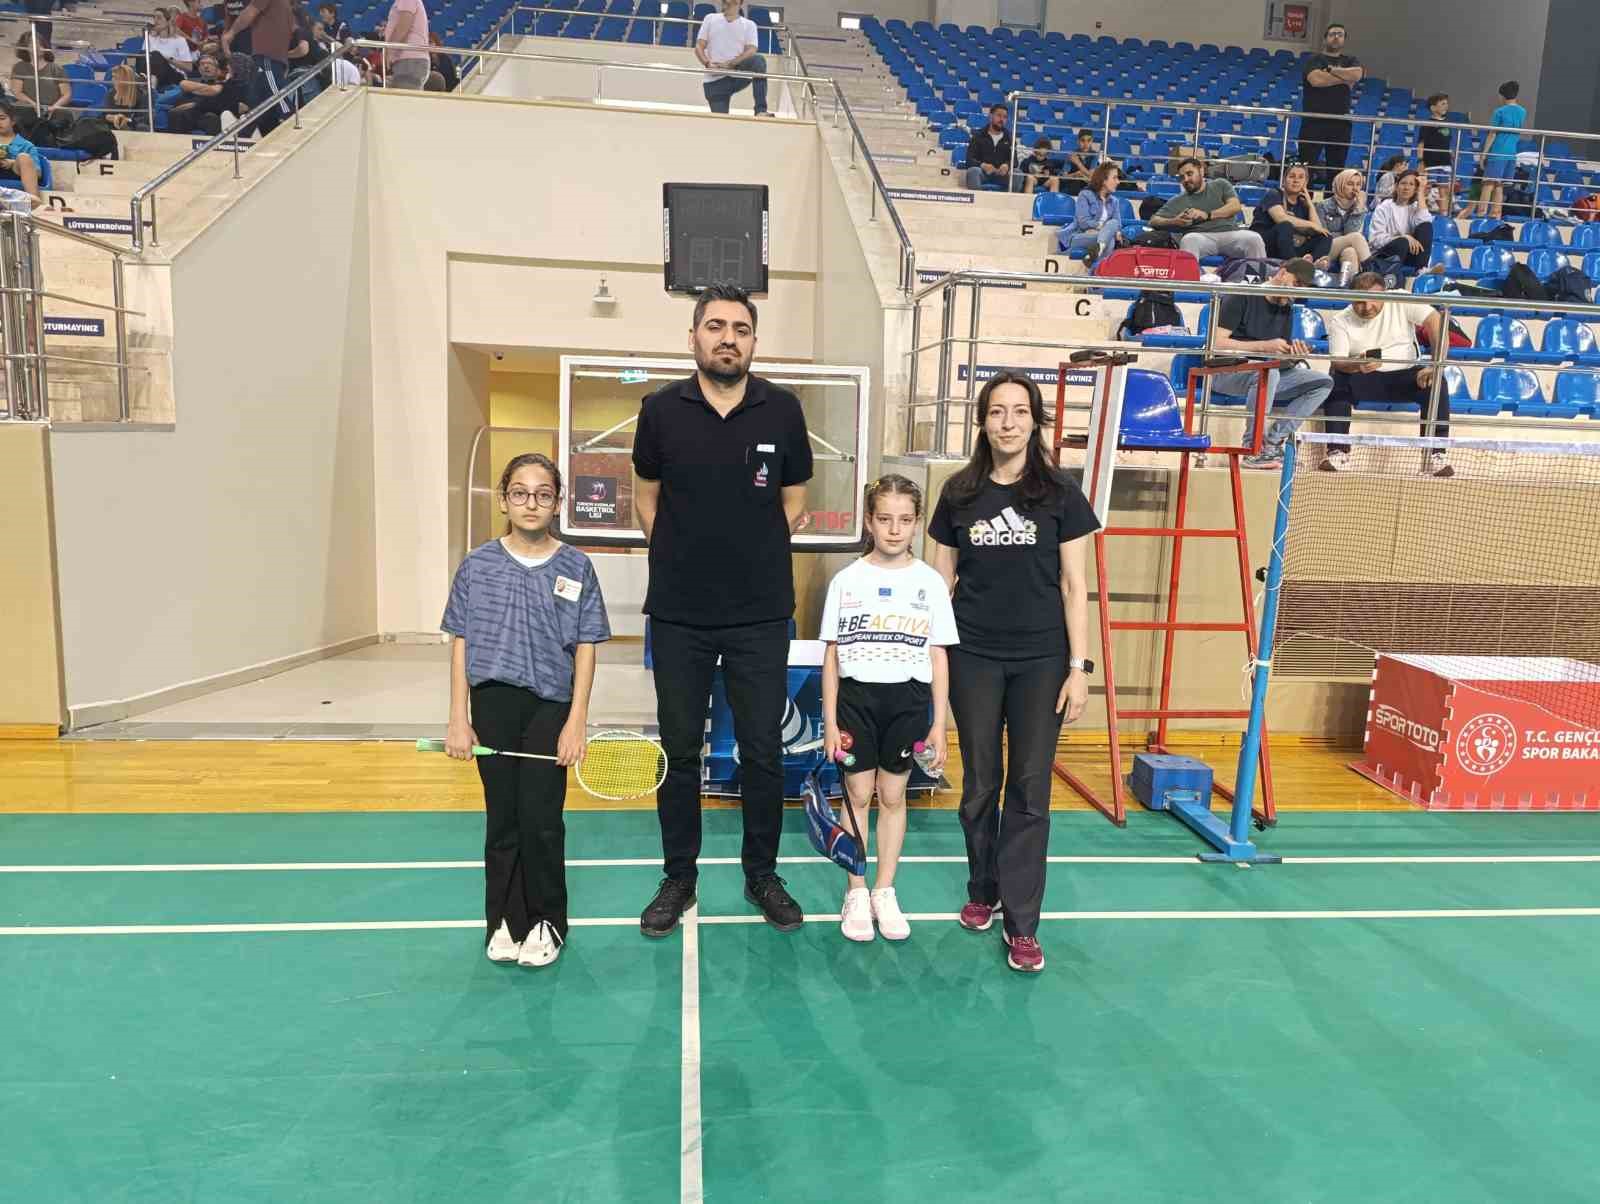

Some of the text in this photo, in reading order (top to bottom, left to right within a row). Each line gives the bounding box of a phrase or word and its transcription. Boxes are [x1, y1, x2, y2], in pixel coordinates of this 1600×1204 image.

[1075, 299, 1091, 316] C
[1045, 373, 1093, 383] OTUMAYINIZ
[970, 529, 1037, 546] adidas
[872, 633, 894, 641] WEEK
[1525, 730, 1550, 743] T.C.
[1522, 747, 1599, 760] SPOR BAKA
